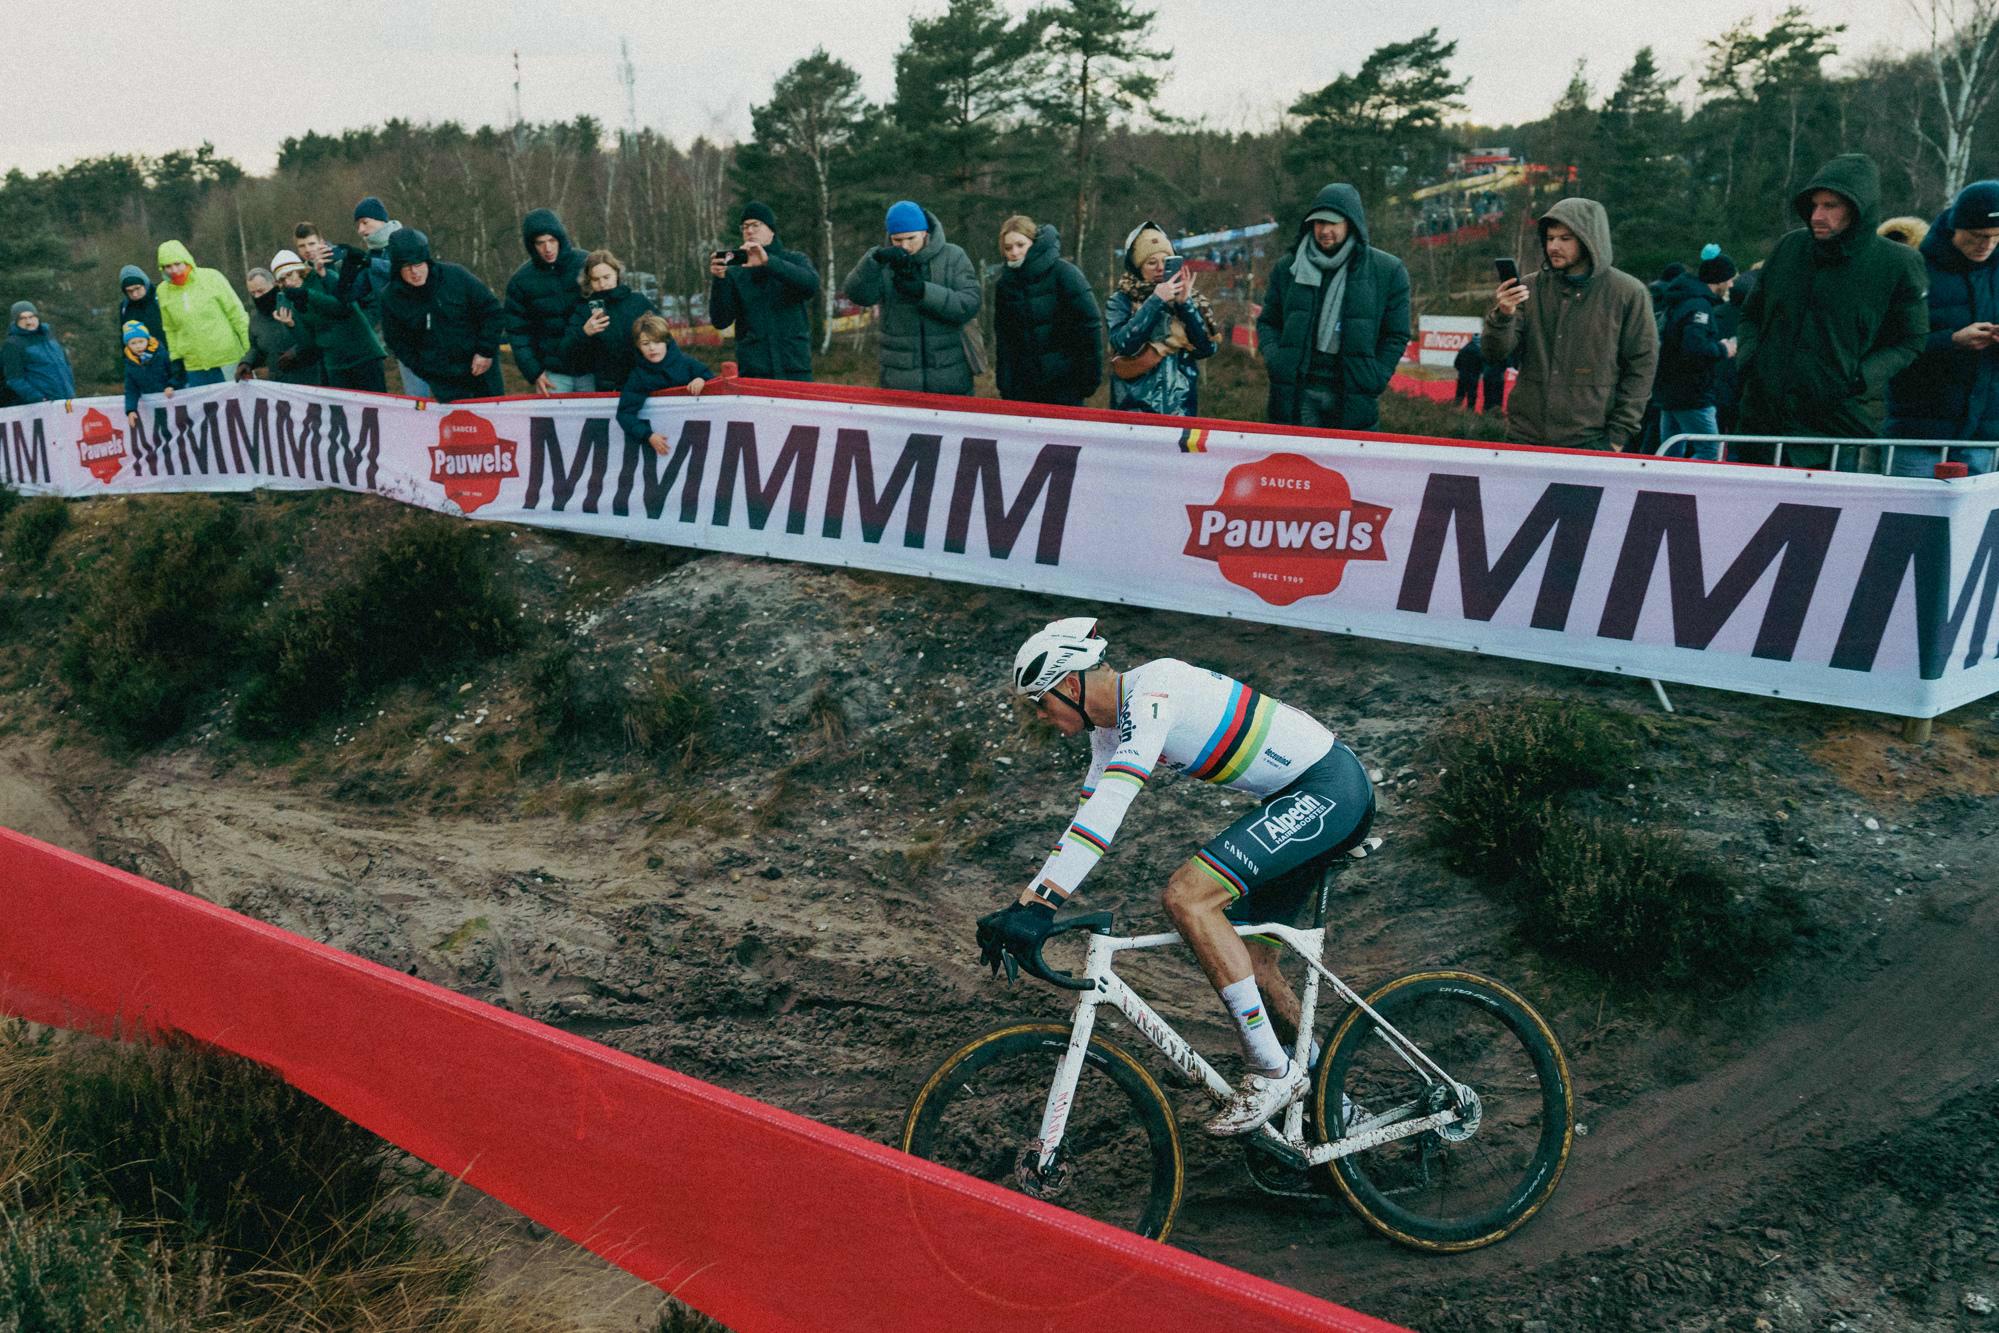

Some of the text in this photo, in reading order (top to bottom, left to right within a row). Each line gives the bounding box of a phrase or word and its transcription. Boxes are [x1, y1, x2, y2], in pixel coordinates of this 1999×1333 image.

[434, 444, 513, 476] Pauwels
[1260, 476, 1311, 490] SAUCES
[1199, 510, 1374, 551] Pauwels
[1252, 571, 1279, 582] SINCE
[1035, 652, 1074, 687] CANYON
[1151, 702, 1159, 720] 1
[1263, 794, 1321, 840] Alpecin
[1224, 840, 1259, 876] CANYON
